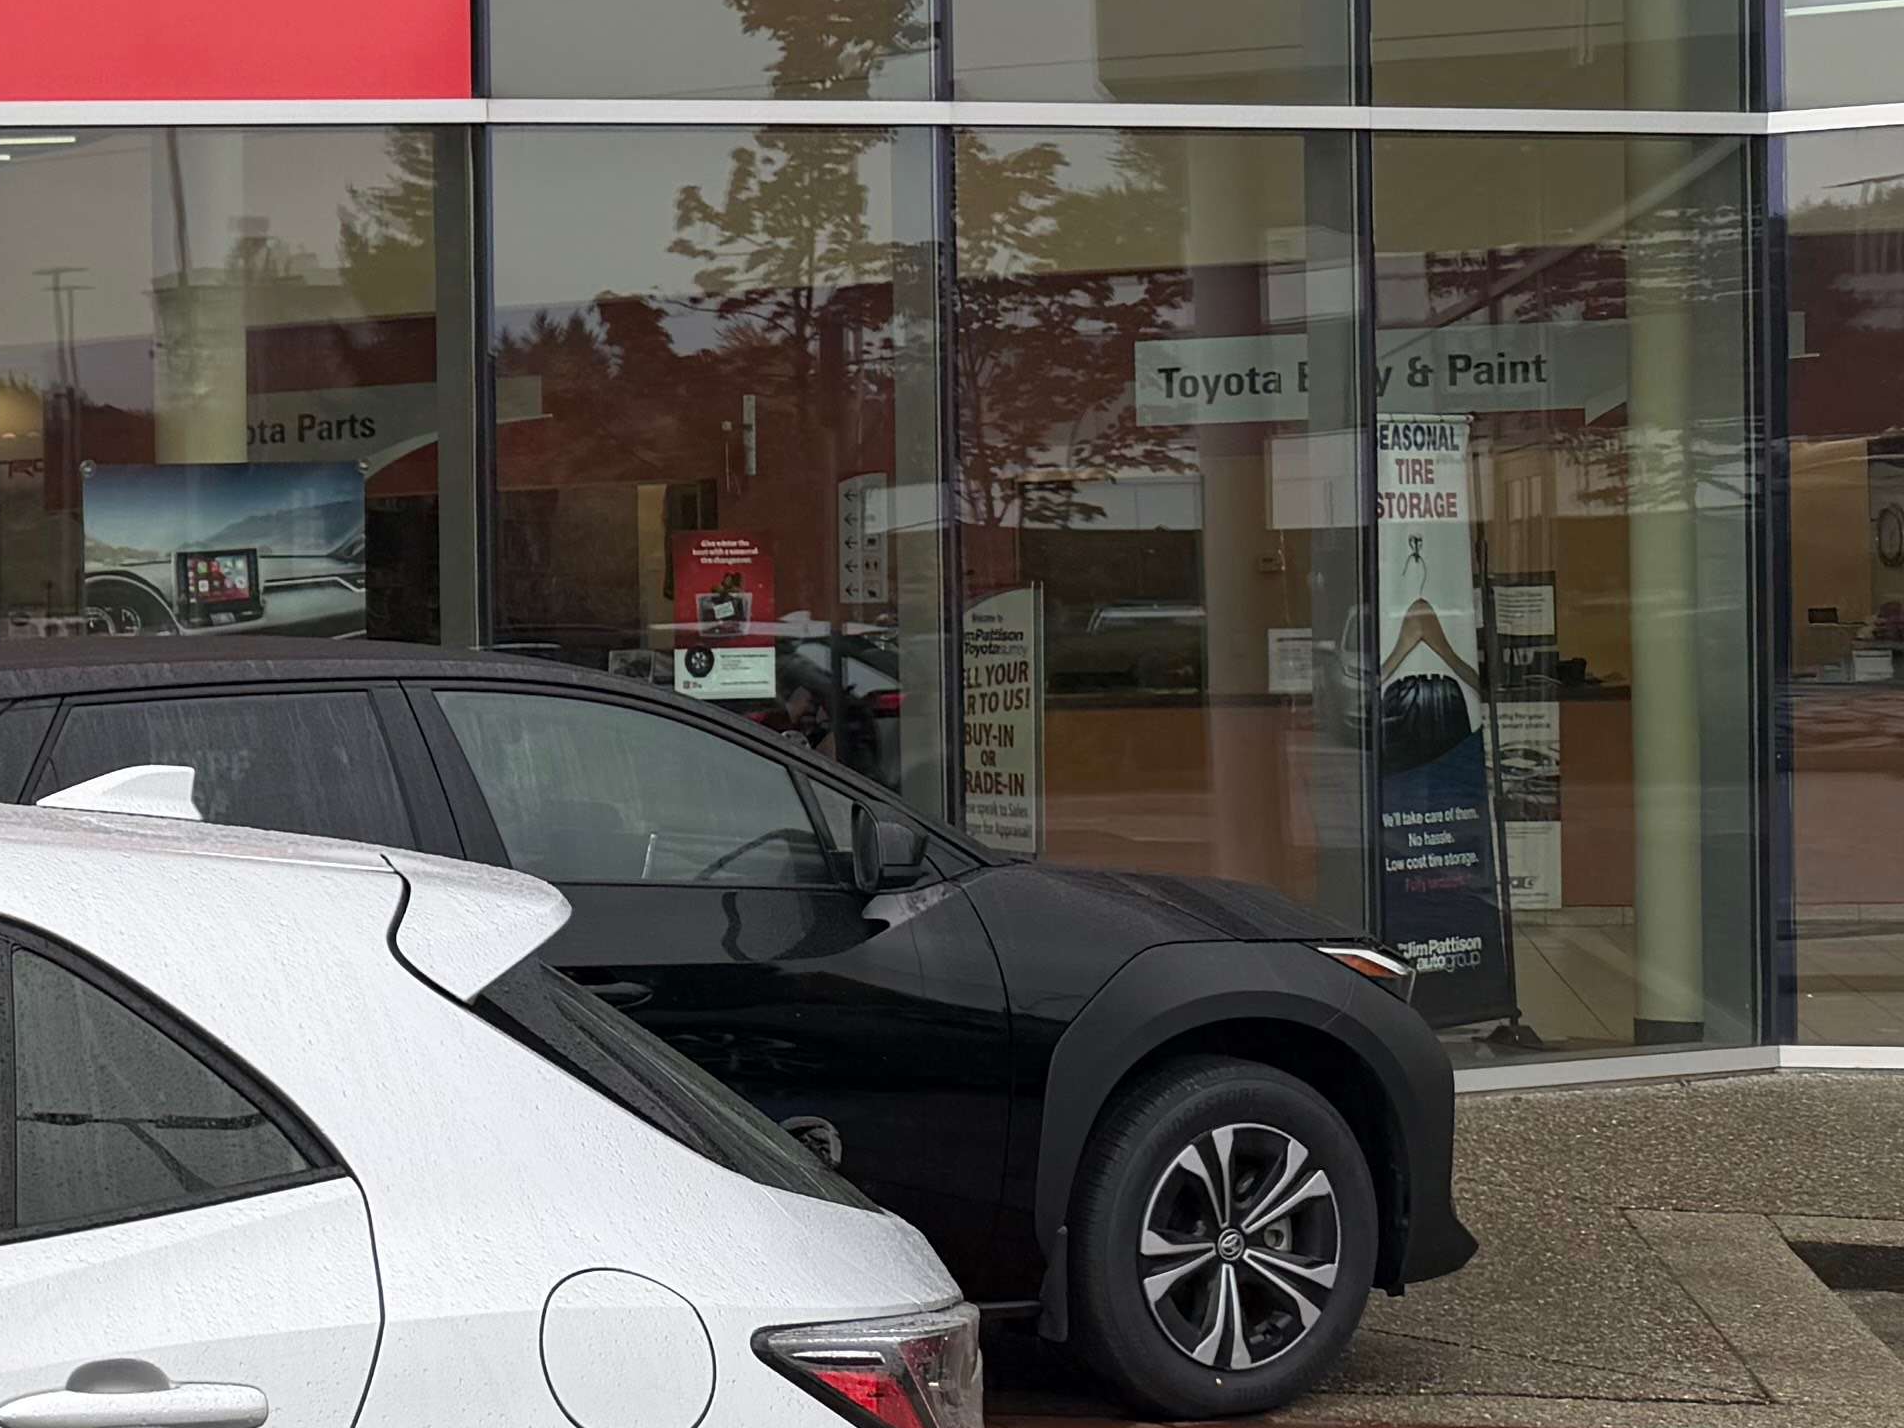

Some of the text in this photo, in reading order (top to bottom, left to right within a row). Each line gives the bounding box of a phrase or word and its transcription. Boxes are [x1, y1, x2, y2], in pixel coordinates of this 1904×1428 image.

[1158, 366, 1282, 404] Toyota
[1406, 356, 1434, 388] &
[1448, 353, 1548, 387] Paint
[297, 413, 376, 444] Parts
[1378, 424, 1461, 453] EASONAL
[1395, 457, 1436, 486] TIRE
[1376, 491, 1458, 519] STORAGE
[985, 660, 1029, 688] YOUR
[979, 691, 999, 715] TO
[1003, 687, 1031, 712] US!
[964, 723, 1014, 749] BUY-IN
[980, 750, 996, 768] OR
[965, 772, 1025, 797] RADE-IN
[1408, 832, 1423, 847] No
[1385, 857, 1406, 872] Low
[1406, 854, 1427, 870] cost
